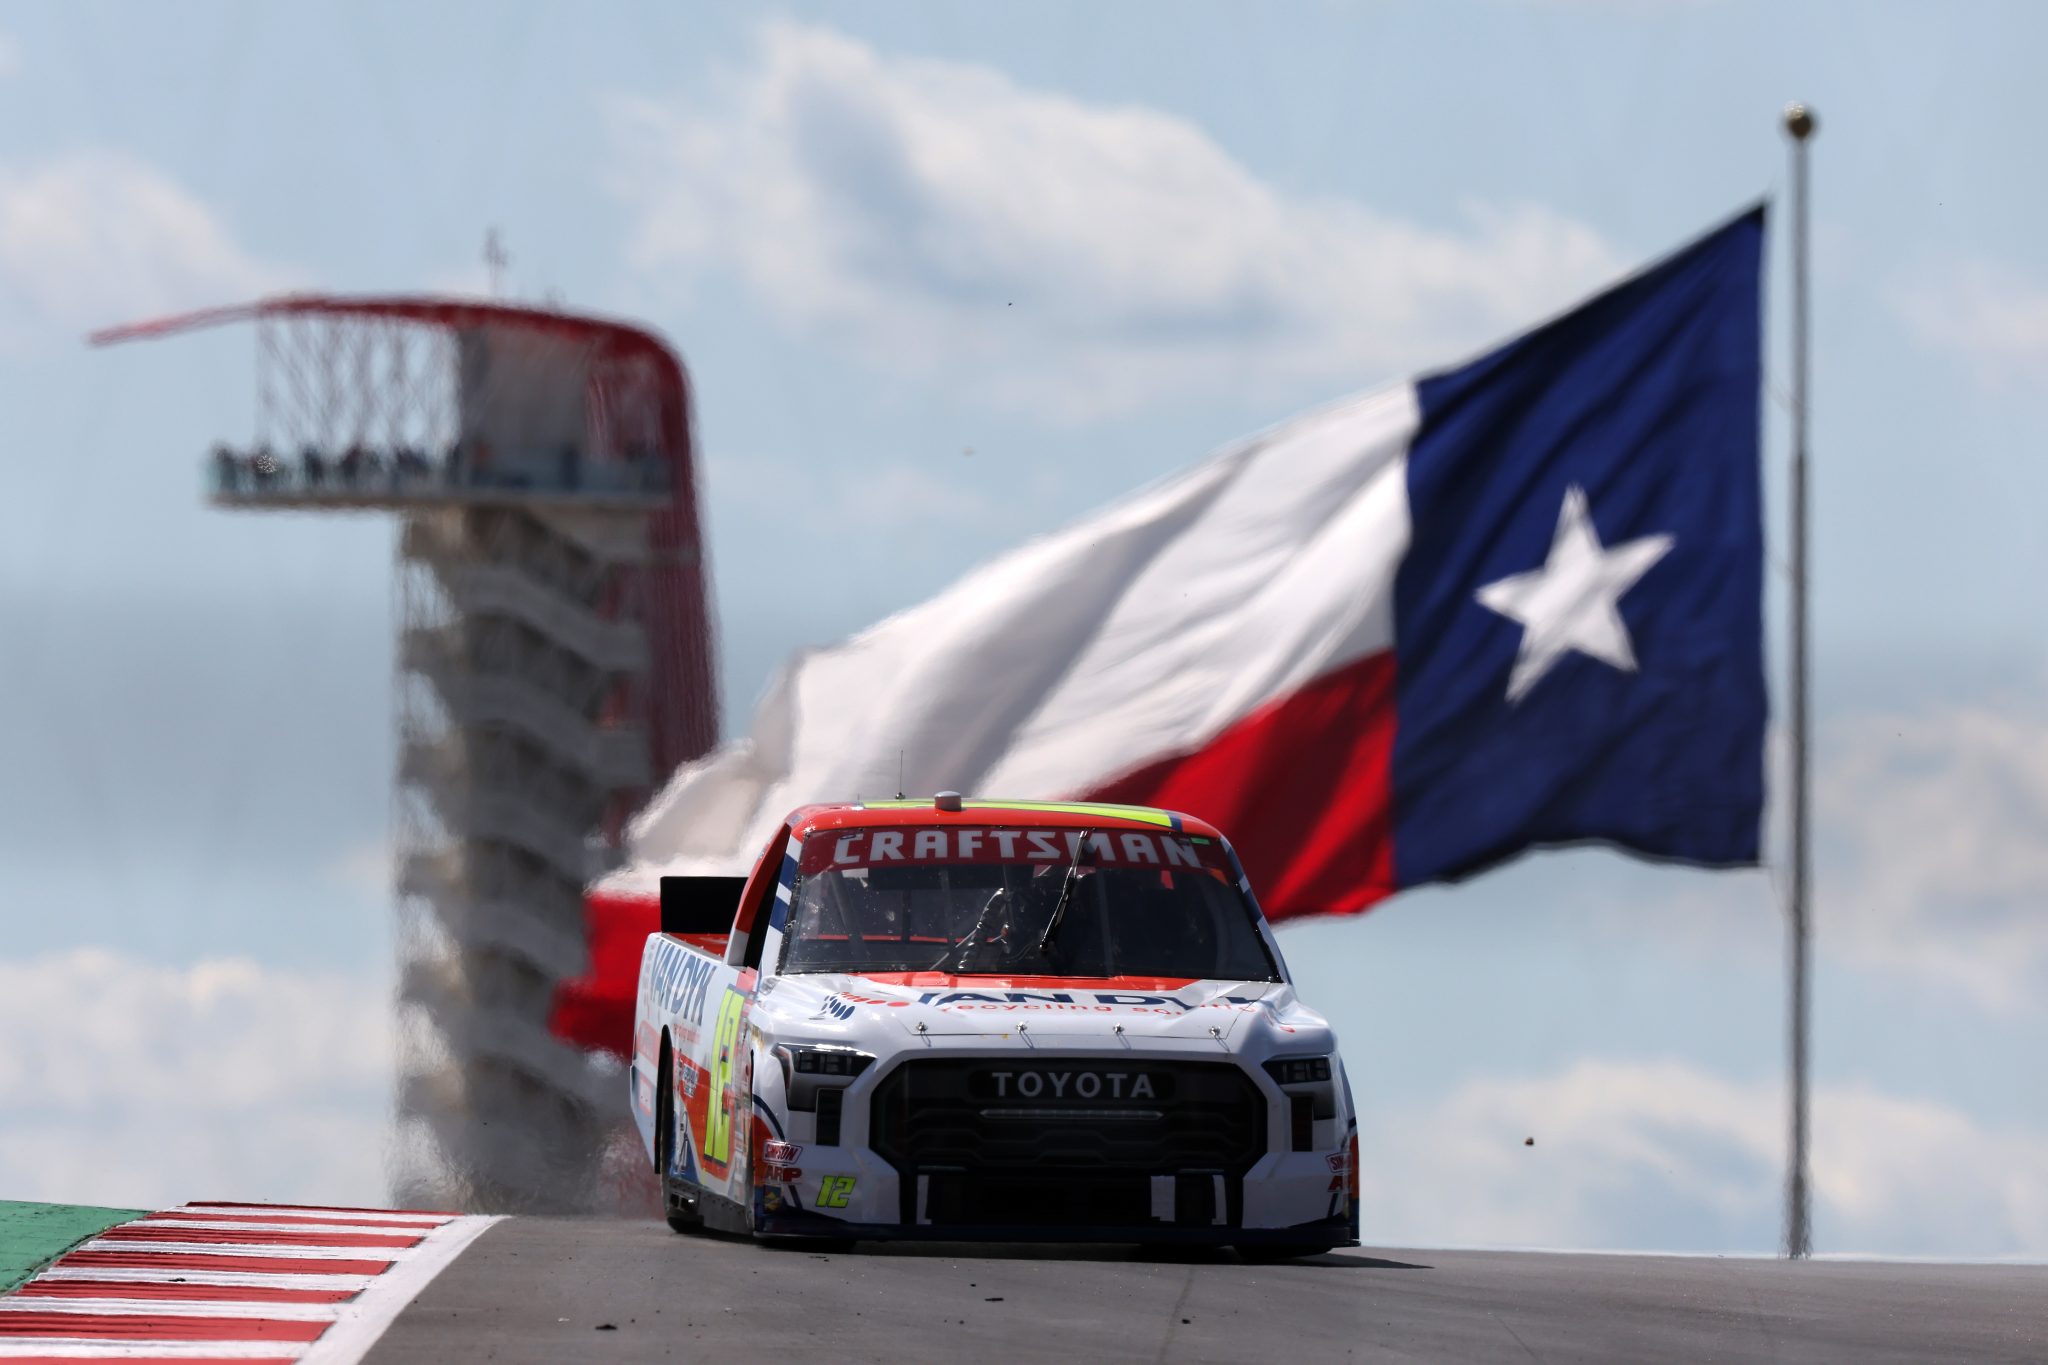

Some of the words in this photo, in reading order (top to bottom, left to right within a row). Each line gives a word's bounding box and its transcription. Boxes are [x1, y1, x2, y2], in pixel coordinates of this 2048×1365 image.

[832, 829, 1202, 868] CRAFTSMAN
[704, 984, 746, 1168] 12
[991, 1071, 1156, 1099] TOYOTA
[815, 1174, 857, 1208] 12
